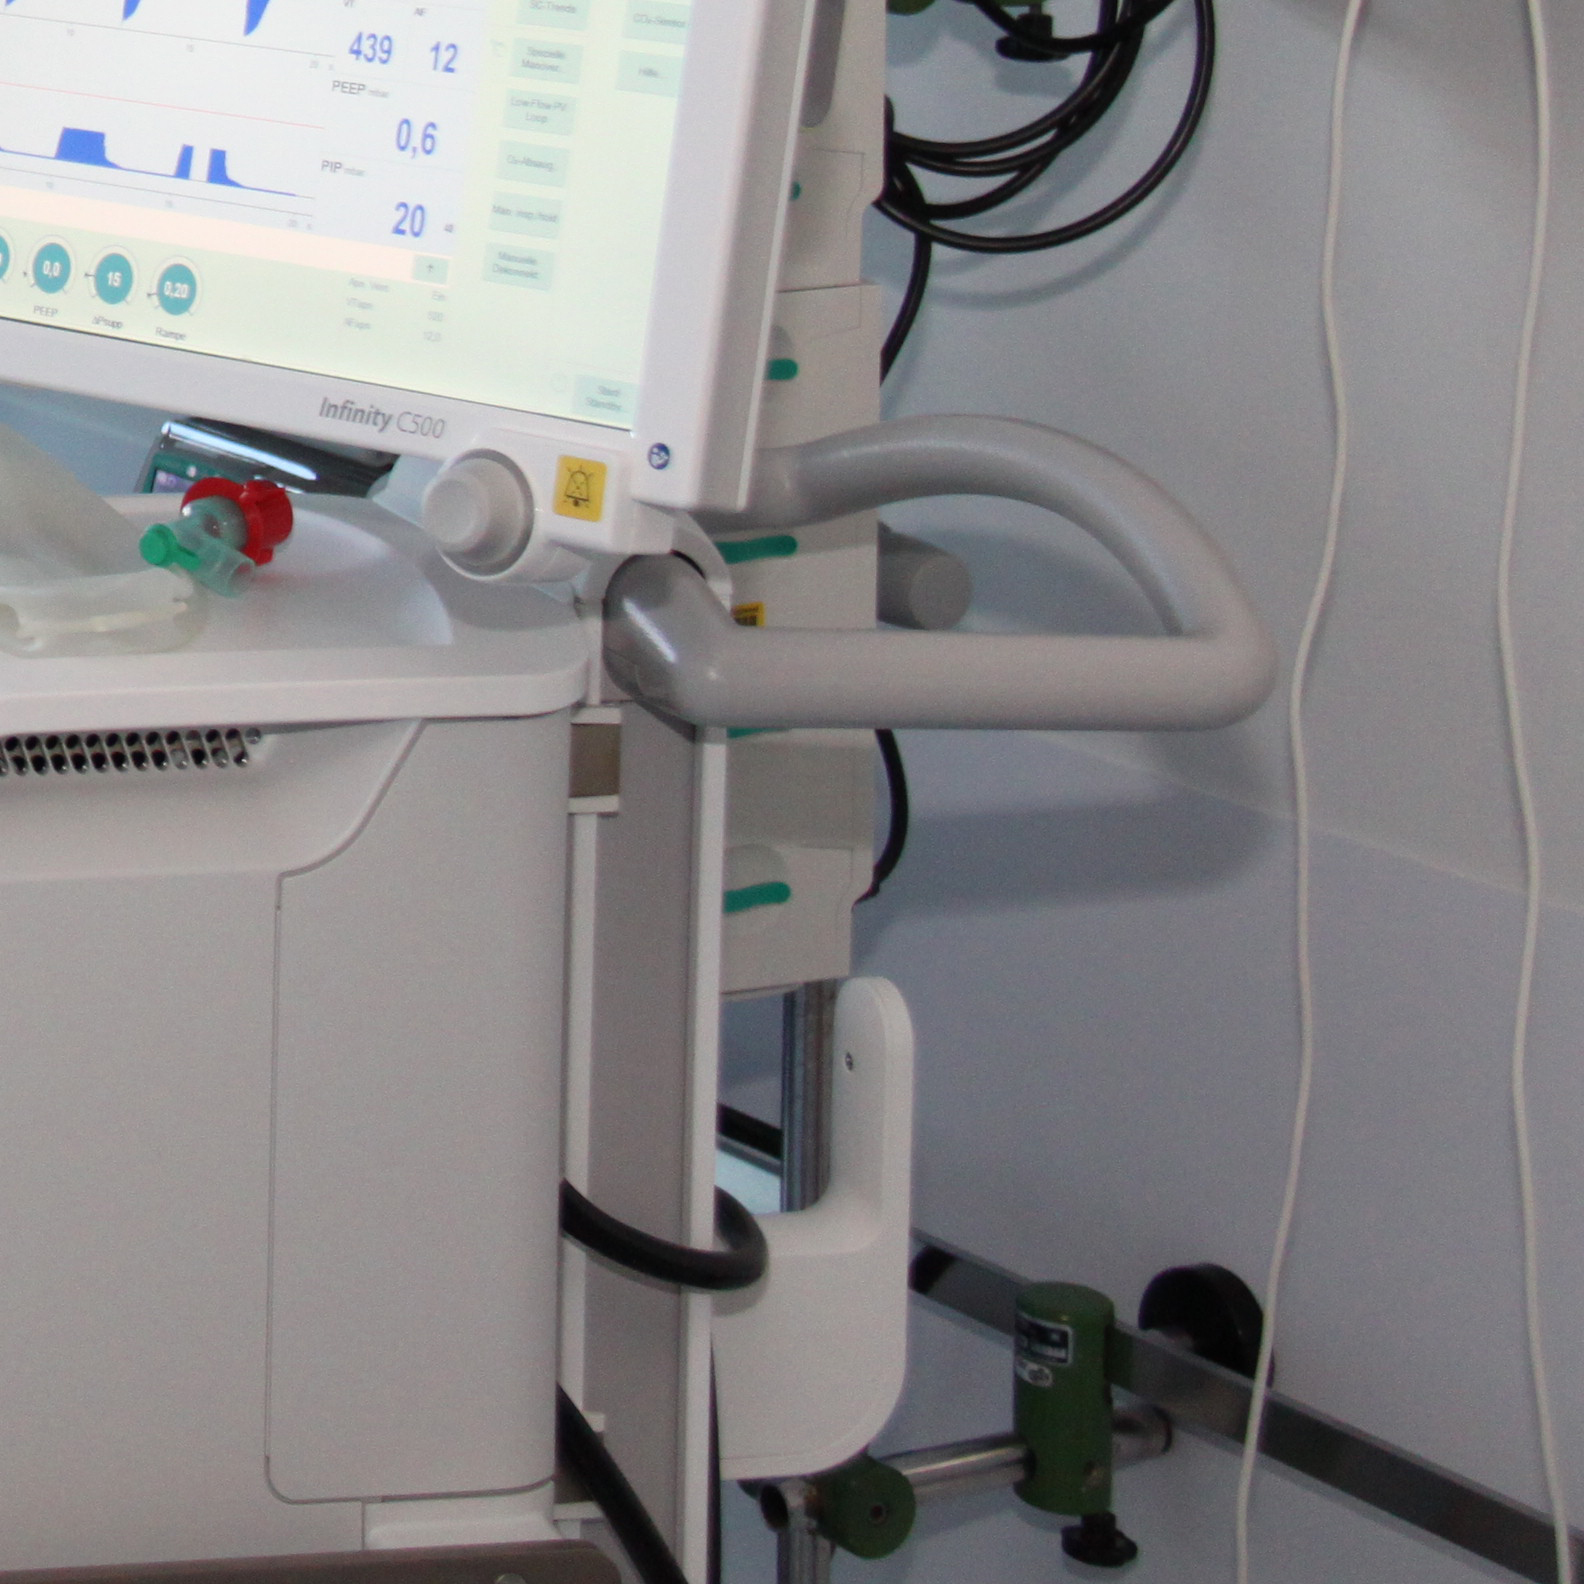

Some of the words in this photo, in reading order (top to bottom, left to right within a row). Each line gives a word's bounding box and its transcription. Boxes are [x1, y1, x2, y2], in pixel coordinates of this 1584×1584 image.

[347, 32, 393, 66] 439
[429, 40, 458, 74] 12
[332, 80, 366, 95] PEEP
[396, 118, 438, 159] 0,6
[321, 160, 343, 173] PIP
[391, 201, 426, 237] 20
[43, 261, 61, 278] 0,0
[106, 271, 122, 287] 15
[163, 280, 190, 299] 0,20
[33, 305, 59, 318] PEEP
[318, 396, 393, 433] Infinity
[395, 410, 446, 440] C500
